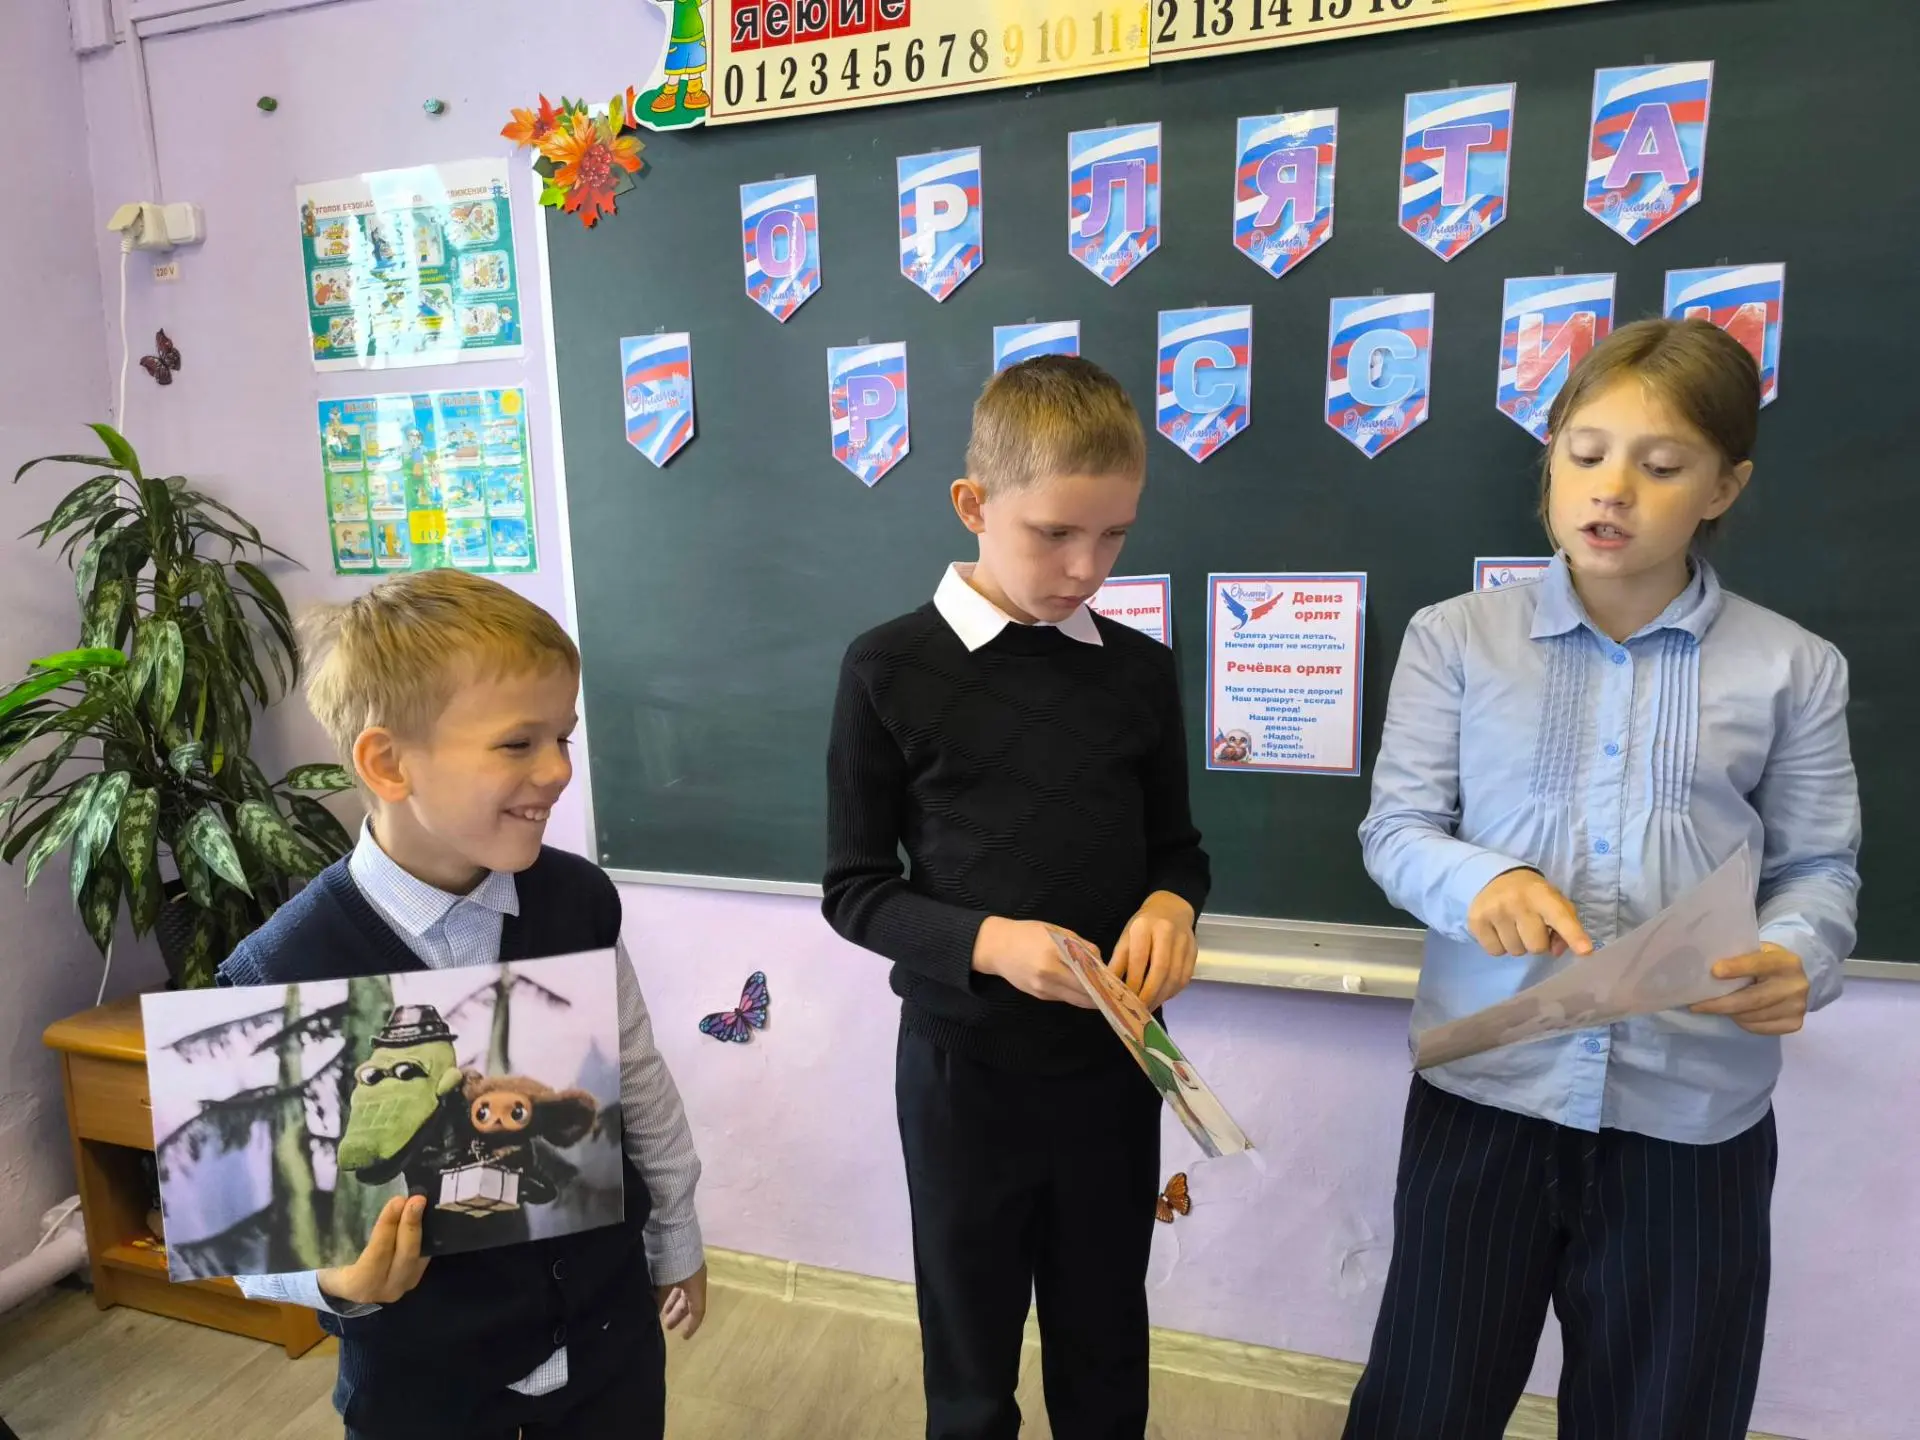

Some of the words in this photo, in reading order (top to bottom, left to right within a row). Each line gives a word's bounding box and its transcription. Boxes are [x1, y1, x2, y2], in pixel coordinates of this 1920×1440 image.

[724, 64, 744, 107] 0
[755, 60, 768, 103] 1
[780, 57, 798, 100] 2
[809, 52, 828, 95] 3
[841, 48, 860, 91] 4
[873, 41, 892, 87] 5
[905, 38, 925, 82] 6
[938, 34, 956, 77] 7
[968, 29, 989, 74] 8
[1422, 122, 1493, 207] Т
[1602, 103, 1690, 189] А
[914, 183, 969, 259] Р
[1079, 157, 1146, 238] Л
[1252, 145, 1319, 228] Я
[755, 208, 807, 279] О
[1173, 339, 1236, 414] С
[1347, 328, 1417, 407] С
[1514, 310, 1597, 391] И
[846, 374, 897, 441] Р
[1292, 591, 1344, 605] Девиз
[1294, 609, 1341, 622] орлят
[1224, 641, 1256, 649] Ничем
[1257, 642, 1284, 650] орлят
[1227, 661, 1292, 674] Речёвка
[1296, 664, 1343, 677] орлят
[1233, 631, 1267, 641] Орлята
[1268, 632, 1300, 641] учатся
[1302, 632, 1337, 641] летать,
[1225, 685, 1245, 693] Нам
[1246, 686, 1287, 695] открыты
[1307, 688, 1343, 696] дороги!
[1249, 713, 1275, 721] Наши
[1253, 696, 1294, 705] маршрут
